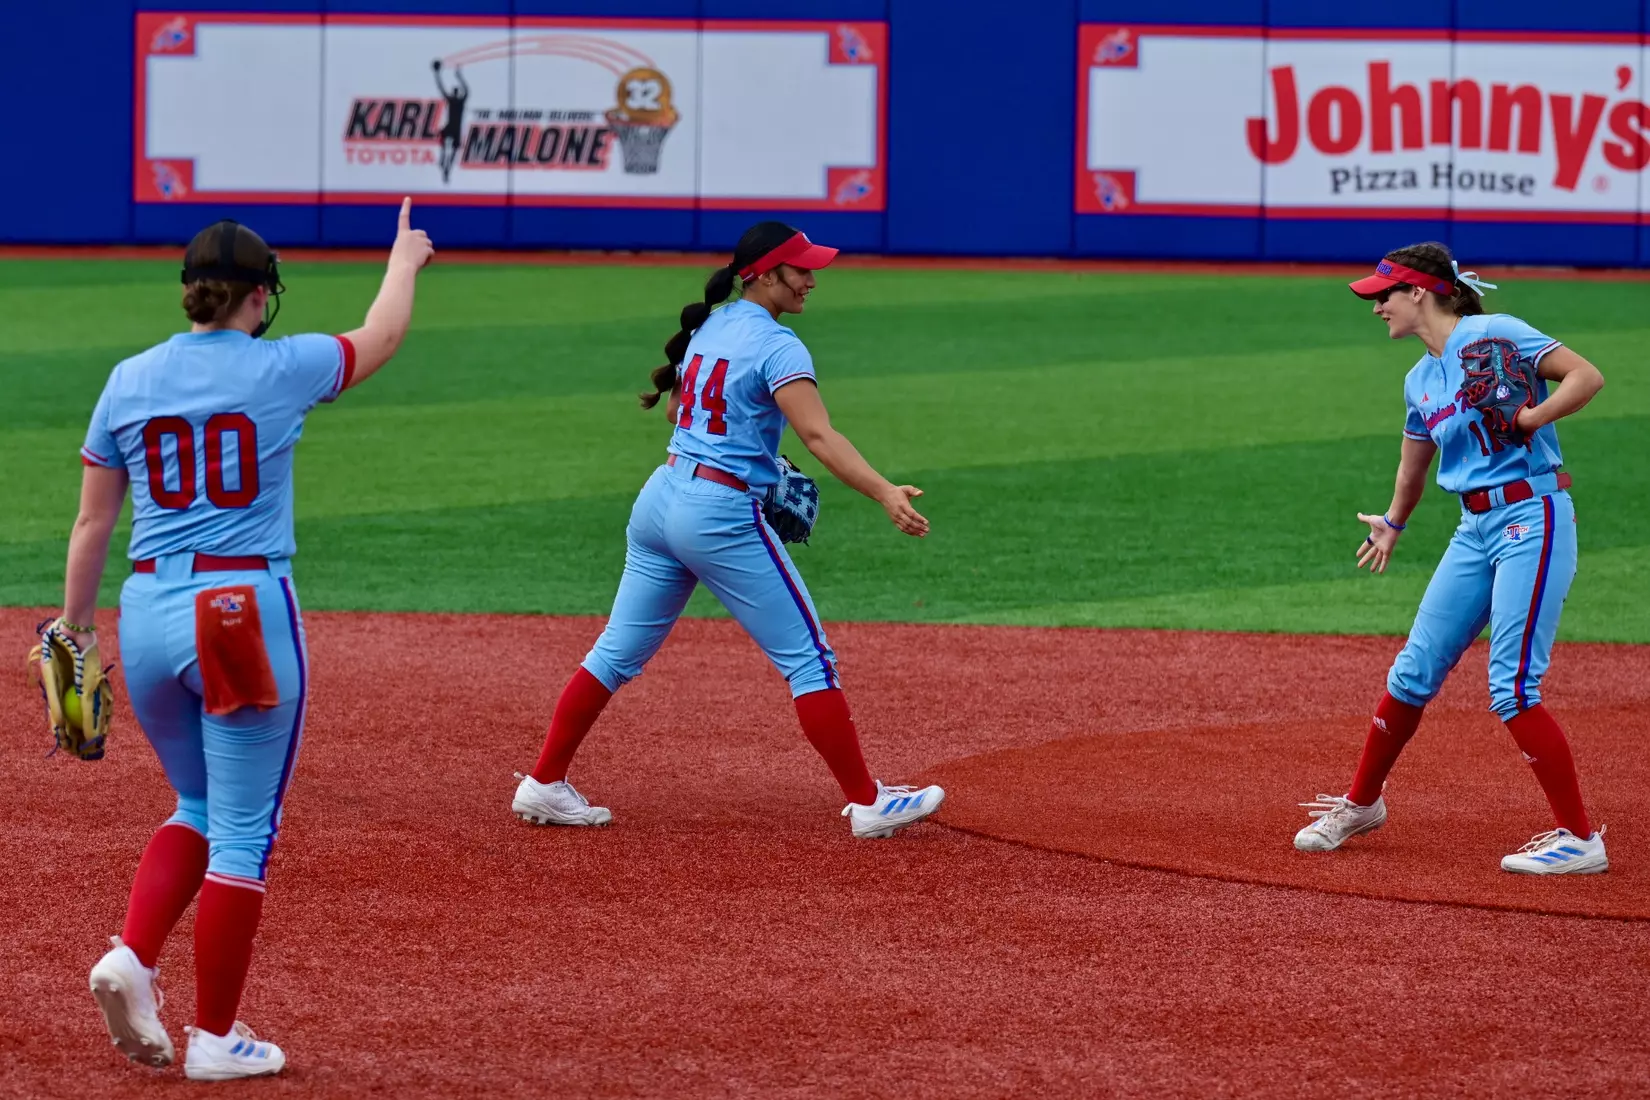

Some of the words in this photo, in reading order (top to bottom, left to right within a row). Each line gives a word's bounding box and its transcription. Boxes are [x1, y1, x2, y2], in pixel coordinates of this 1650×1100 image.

[346, 99, 438, 139] KARL
[1245, 60, 1650, 192] Johnny's
[346, 148, 435, 165] TOYOTA
[463, 125, 609, 166] MALONE
[1330, 165, 1419, 194] Pizza
[1430, 162, 1536, 195] House
[678, 353, 730, 436] 44
[142, 412, 260, 510] 00
